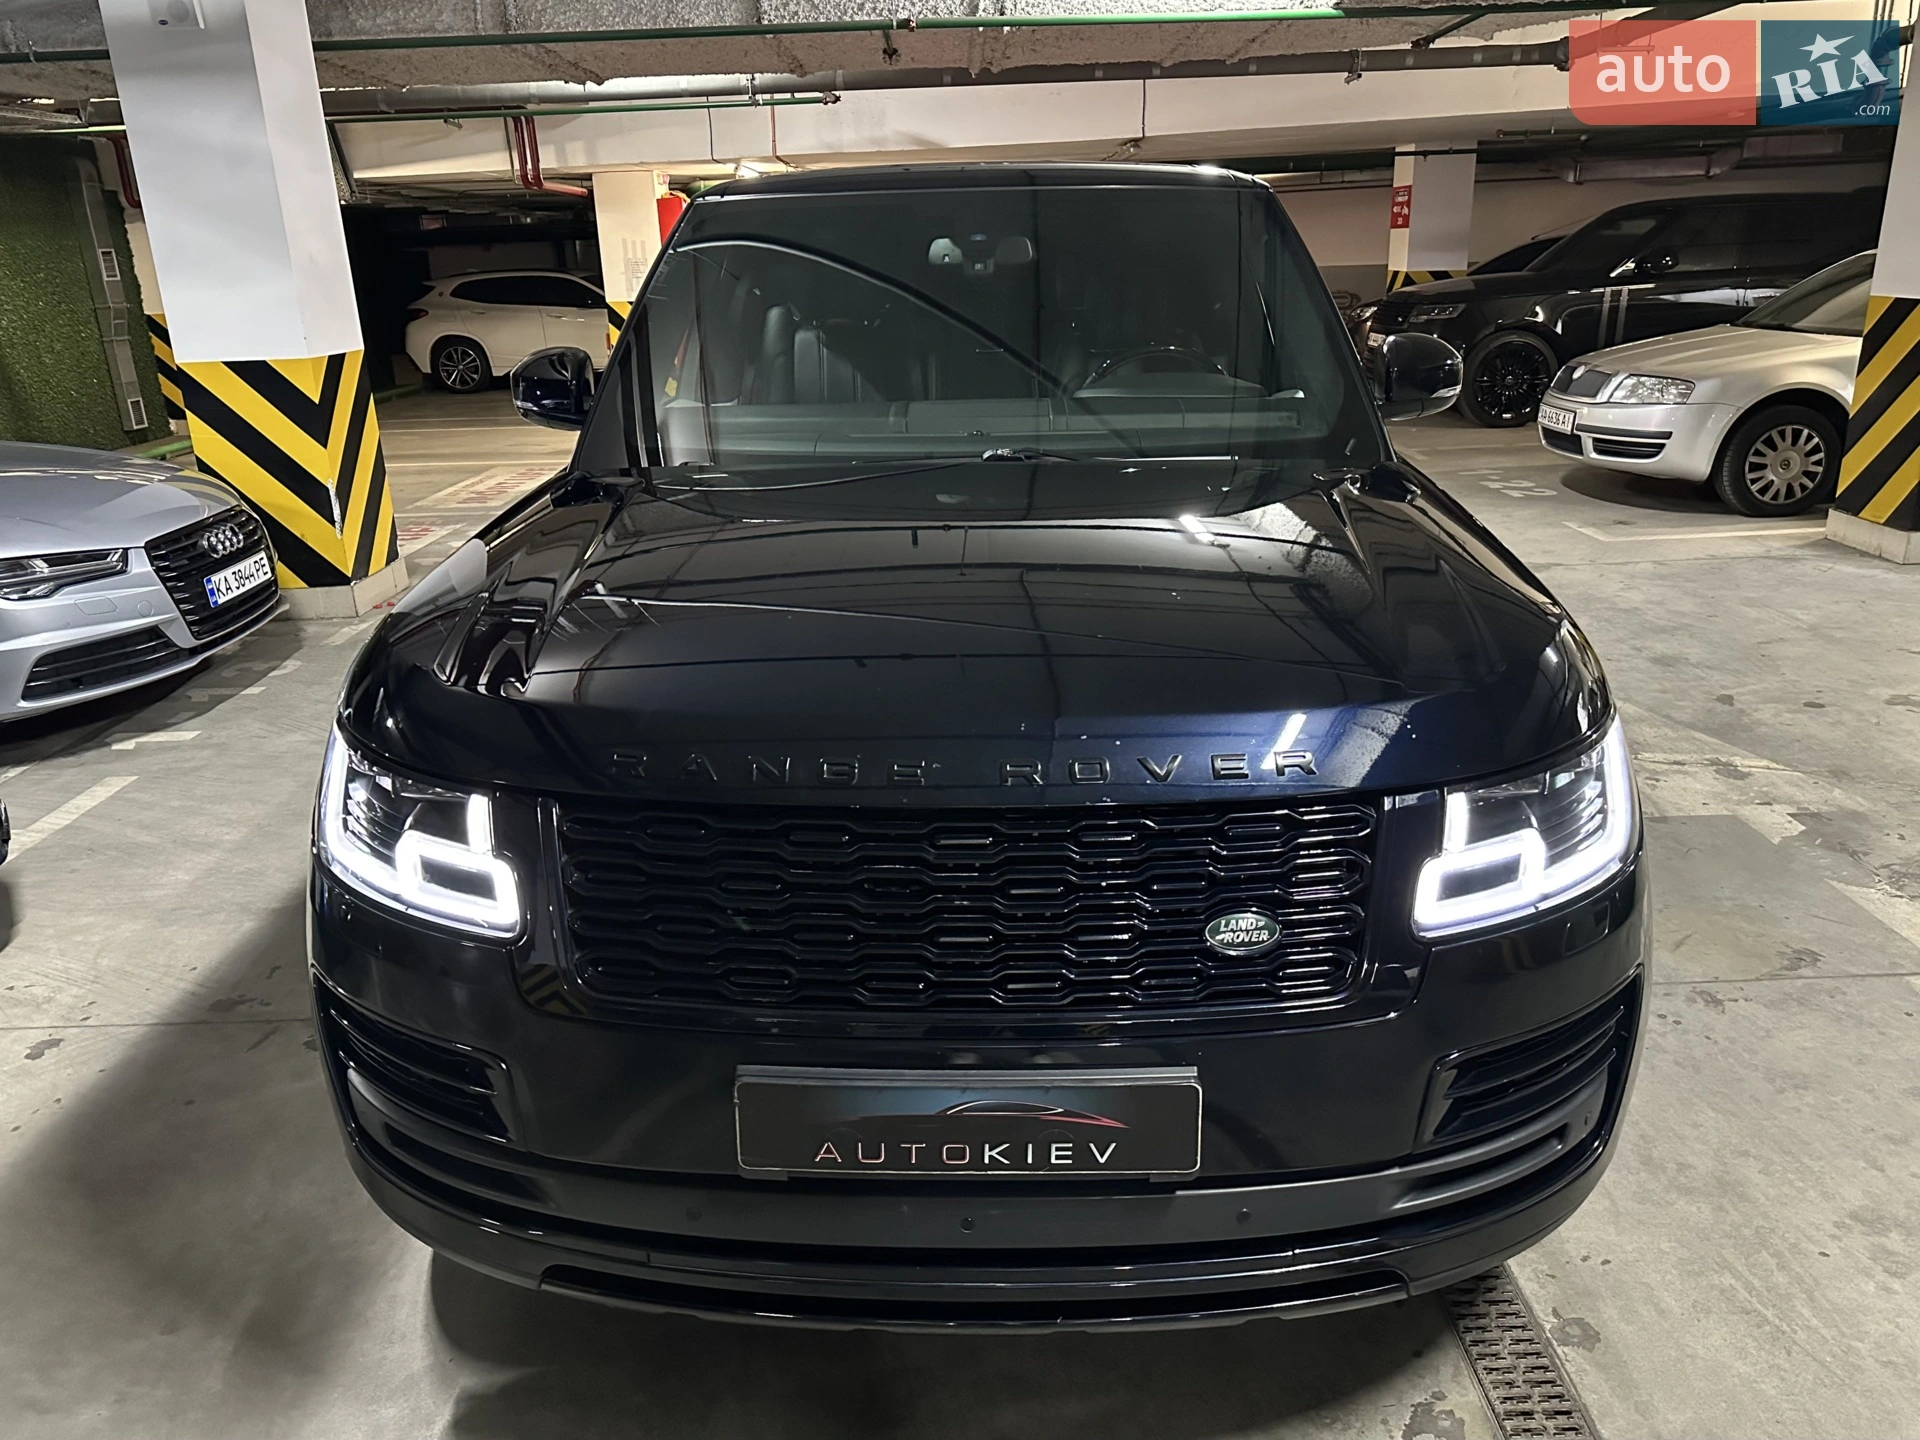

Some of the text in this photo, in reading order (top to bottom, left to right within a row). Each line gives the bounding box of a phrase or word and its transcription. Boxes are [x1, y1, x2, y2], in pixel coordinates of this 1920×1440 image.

[214, 557, 268, 599] KA 3844 PE
[609, 750, 1319, 786] RANGE ROVER
[1220, 918, 1257, 931] LAND
[1223, 930, 1269, 944] ROVER
[815, 1142, 1118, 1165] AUTOKIEV
